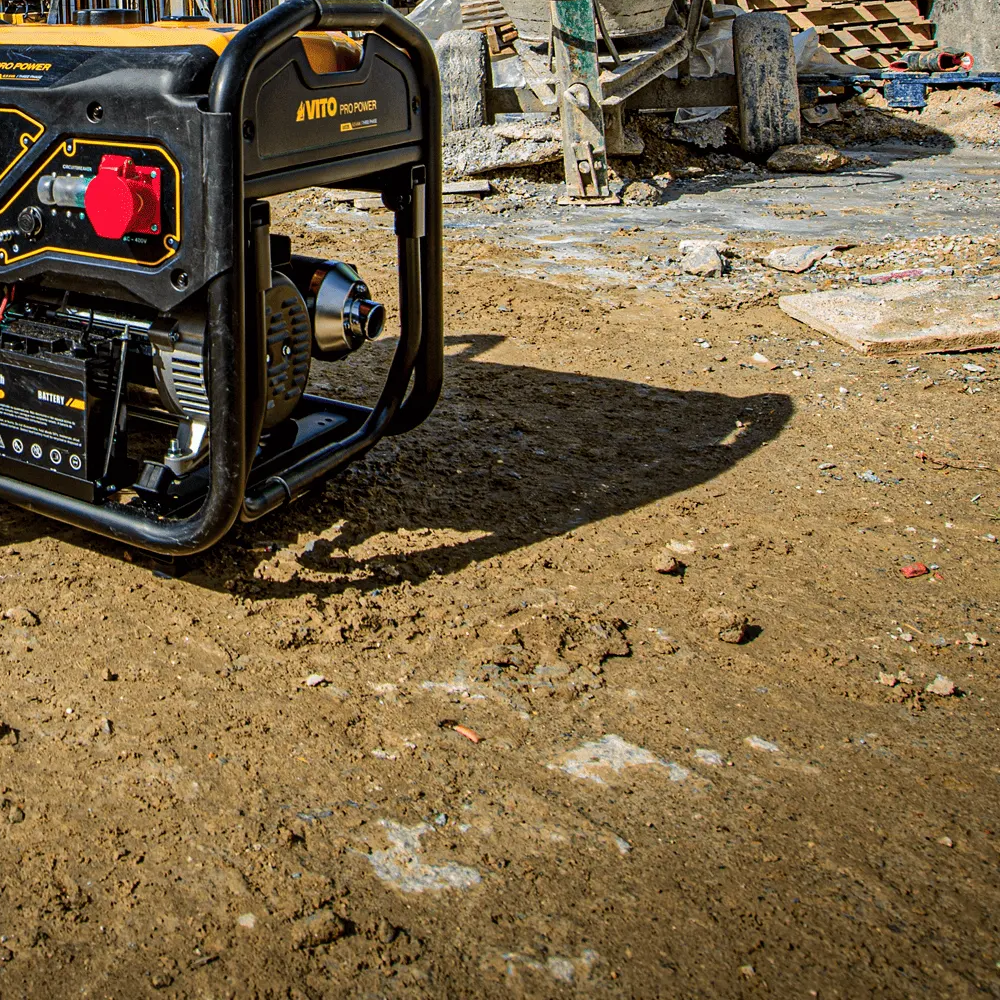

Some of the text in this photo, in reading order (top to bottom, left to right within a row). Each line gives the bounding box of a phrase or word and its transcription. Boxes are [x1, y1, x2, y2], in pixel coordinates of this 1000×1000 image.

[13, 62, 52, 71] POWER
[305, 96, 377, 120] VITO PRO POWER
[37, 390, 65, 406] BATTERY
